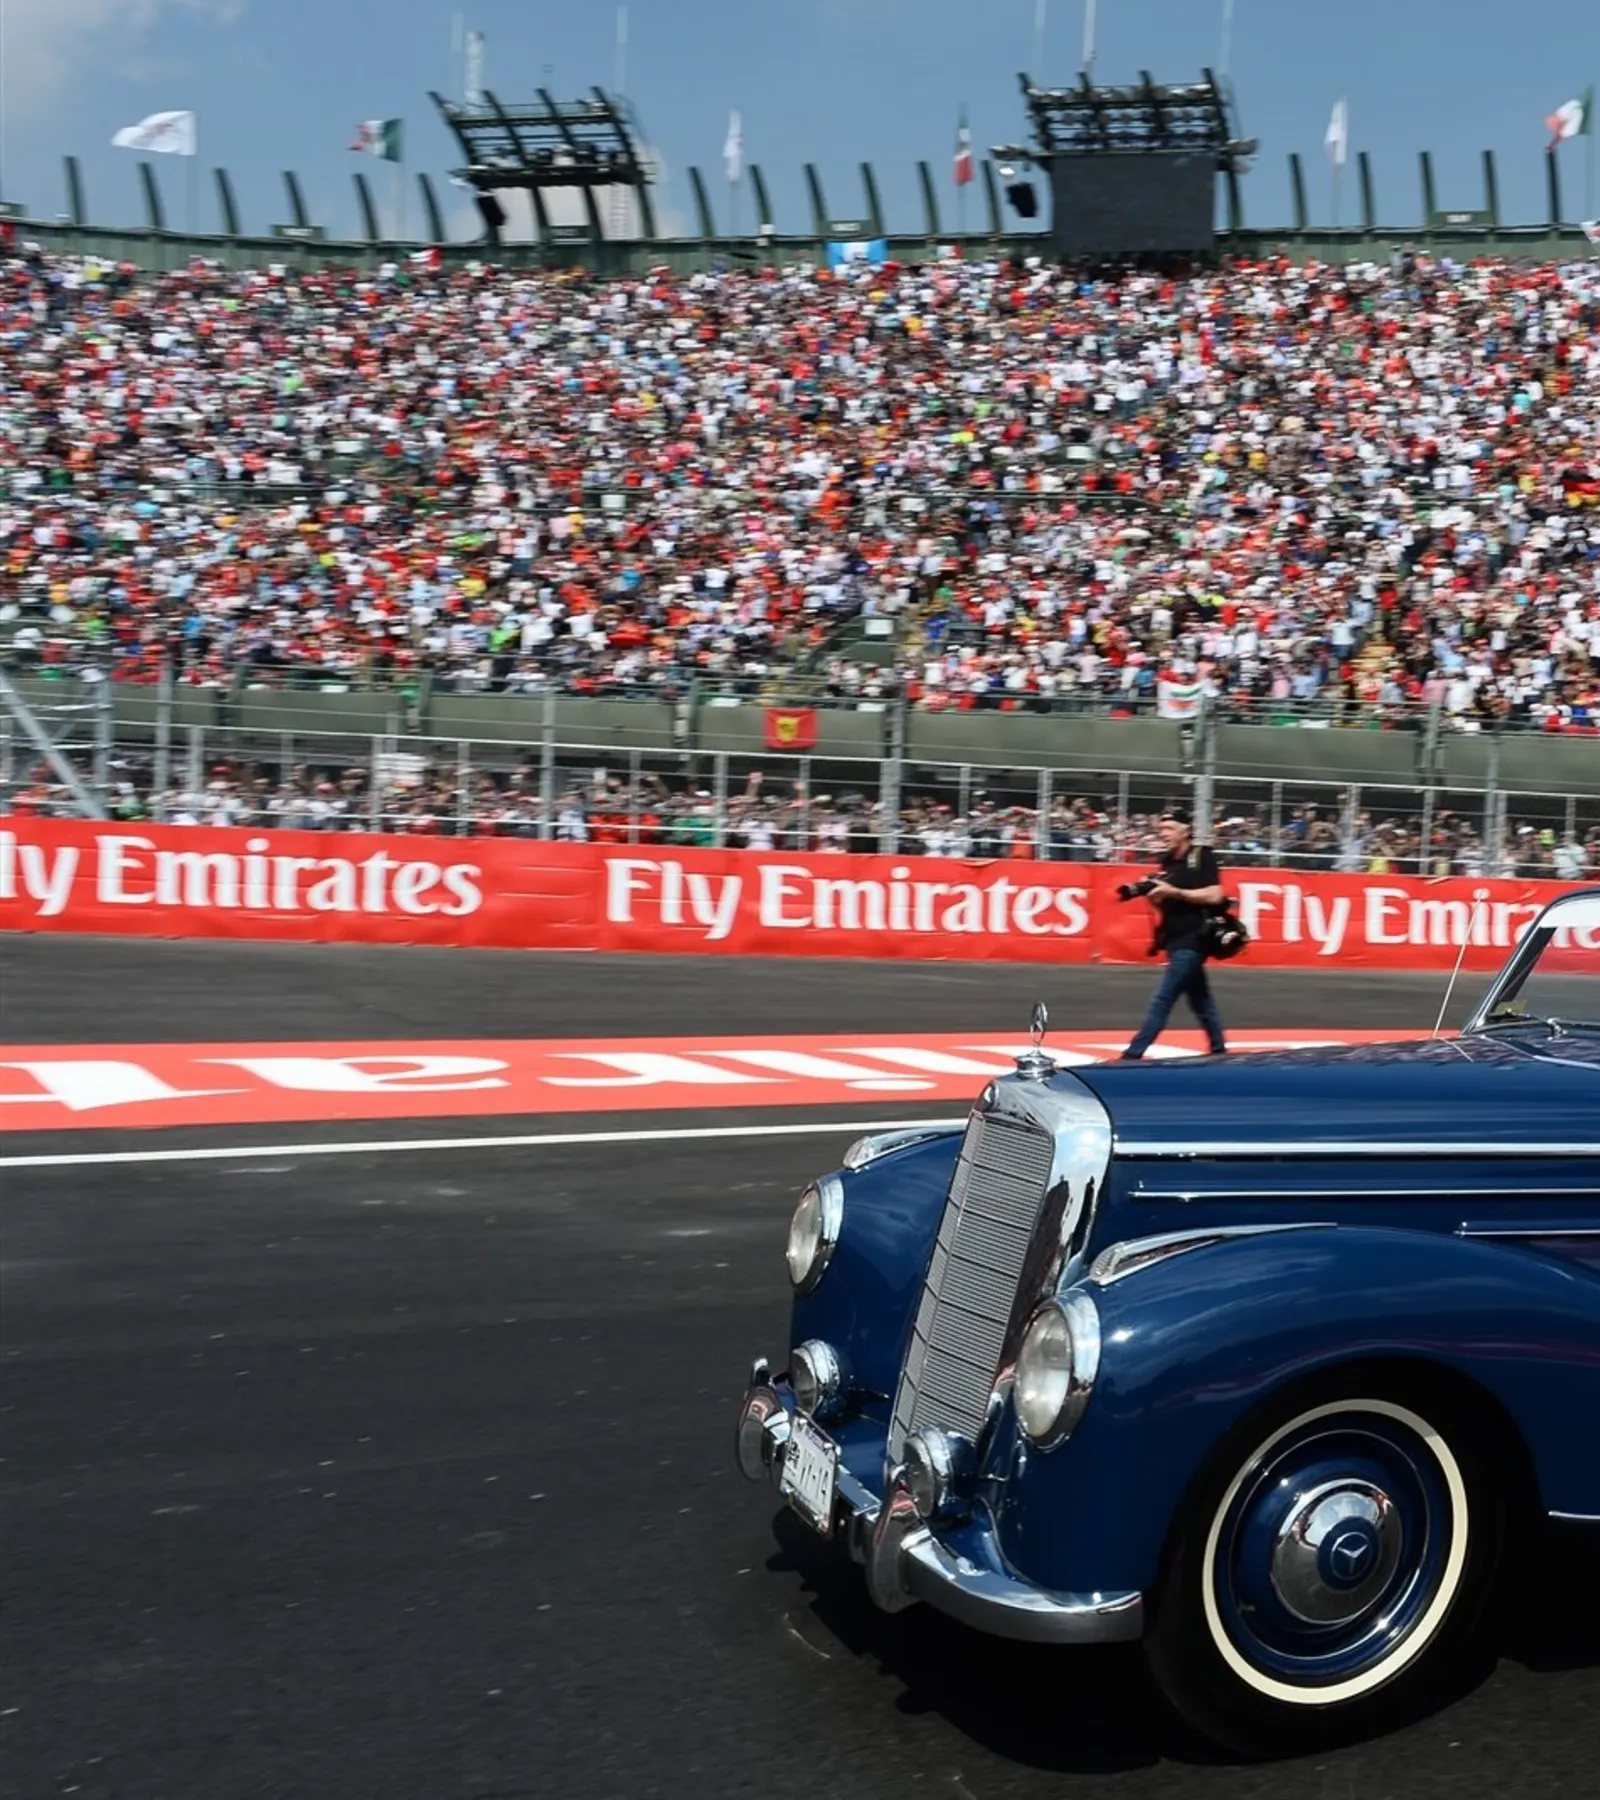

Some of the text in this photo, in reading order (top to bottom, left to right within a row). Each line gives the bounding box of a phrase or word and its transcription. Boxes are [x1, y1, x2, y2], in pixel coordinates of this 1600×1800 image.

[94, 835, 483, 916] Emirates
[605, 857, 1090, 939] Fly Emirates
[1237, 882, 1352, 956] Fly
